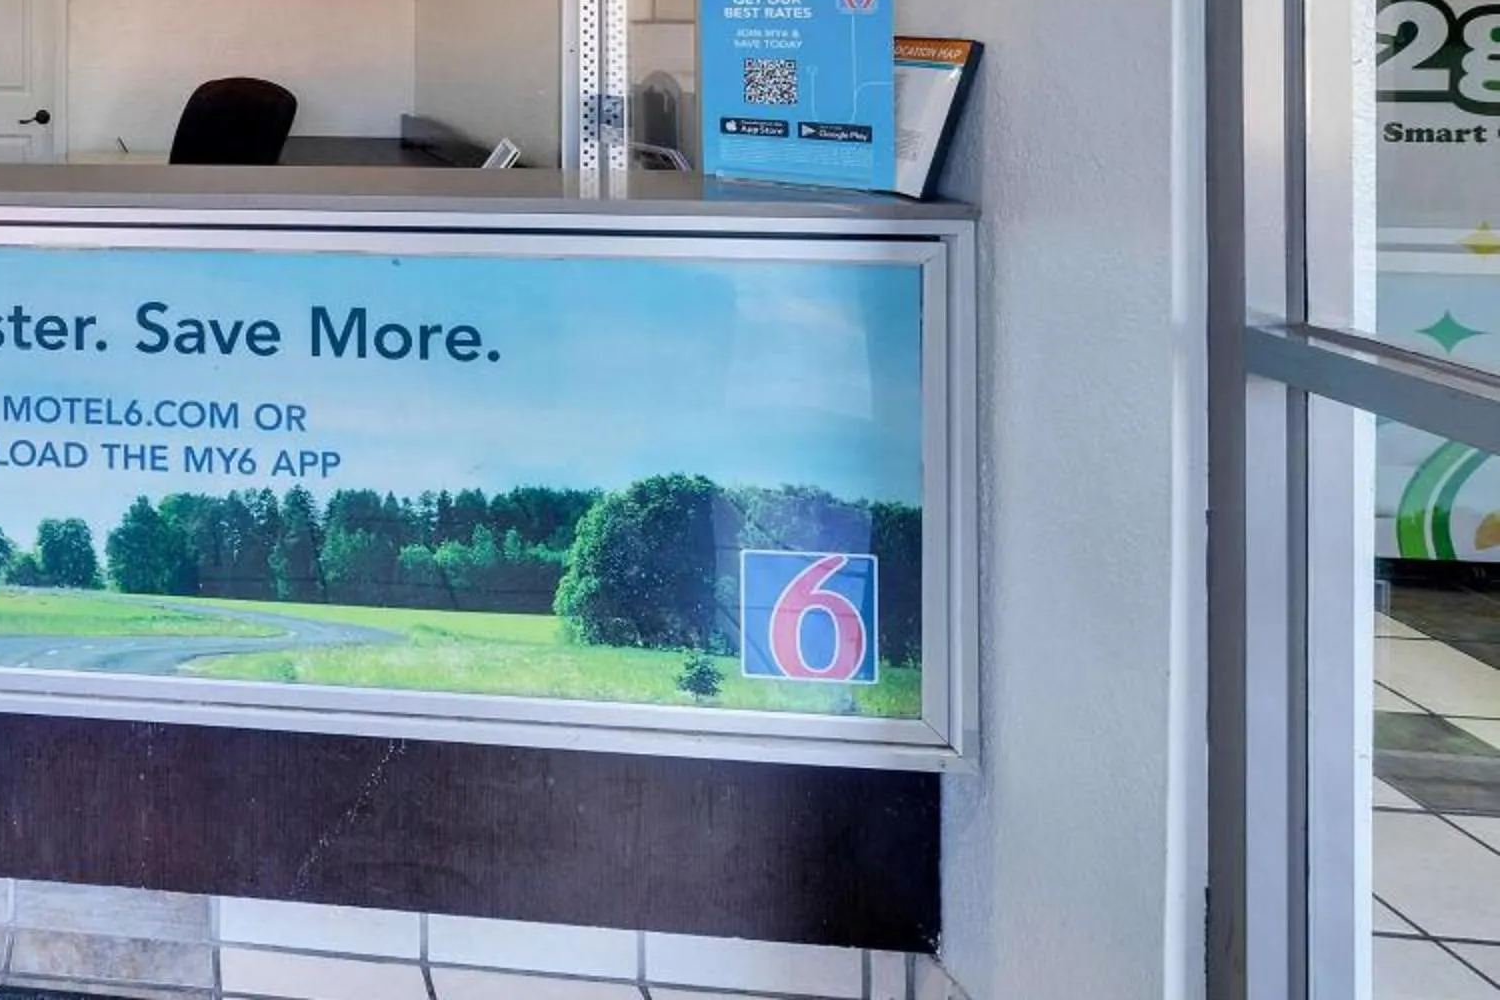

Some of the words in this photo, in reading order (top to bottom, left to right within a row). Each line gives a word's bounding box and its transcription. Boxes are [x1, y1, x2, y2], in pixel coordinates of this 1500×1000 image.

[724, 7, 760, 19] BEST
[764, 7, 813, 19] RATES
[734, 40, 760, 49] SAVE
[764, 40, 803, 49] TODAY
[740, 125, 760, 135] App
[760, 126, 784, 135] Store
[819, 130, 848, 140] Google
[850, 132, 869, 141] Play
[1383, 121, 1488, 143] Smart
[135, 301, 282, 357] Save
[311, 305, 501, 363] More.
[3, 395, 239, 430] MOTEL6.COM
[254, 403, 307, 432] OR
[100, 443, 169, 472] THE
[184, 446, 257, 476] MY6
[271, 449, 341, 478] APP
[769, 553, 867, 682] 6
